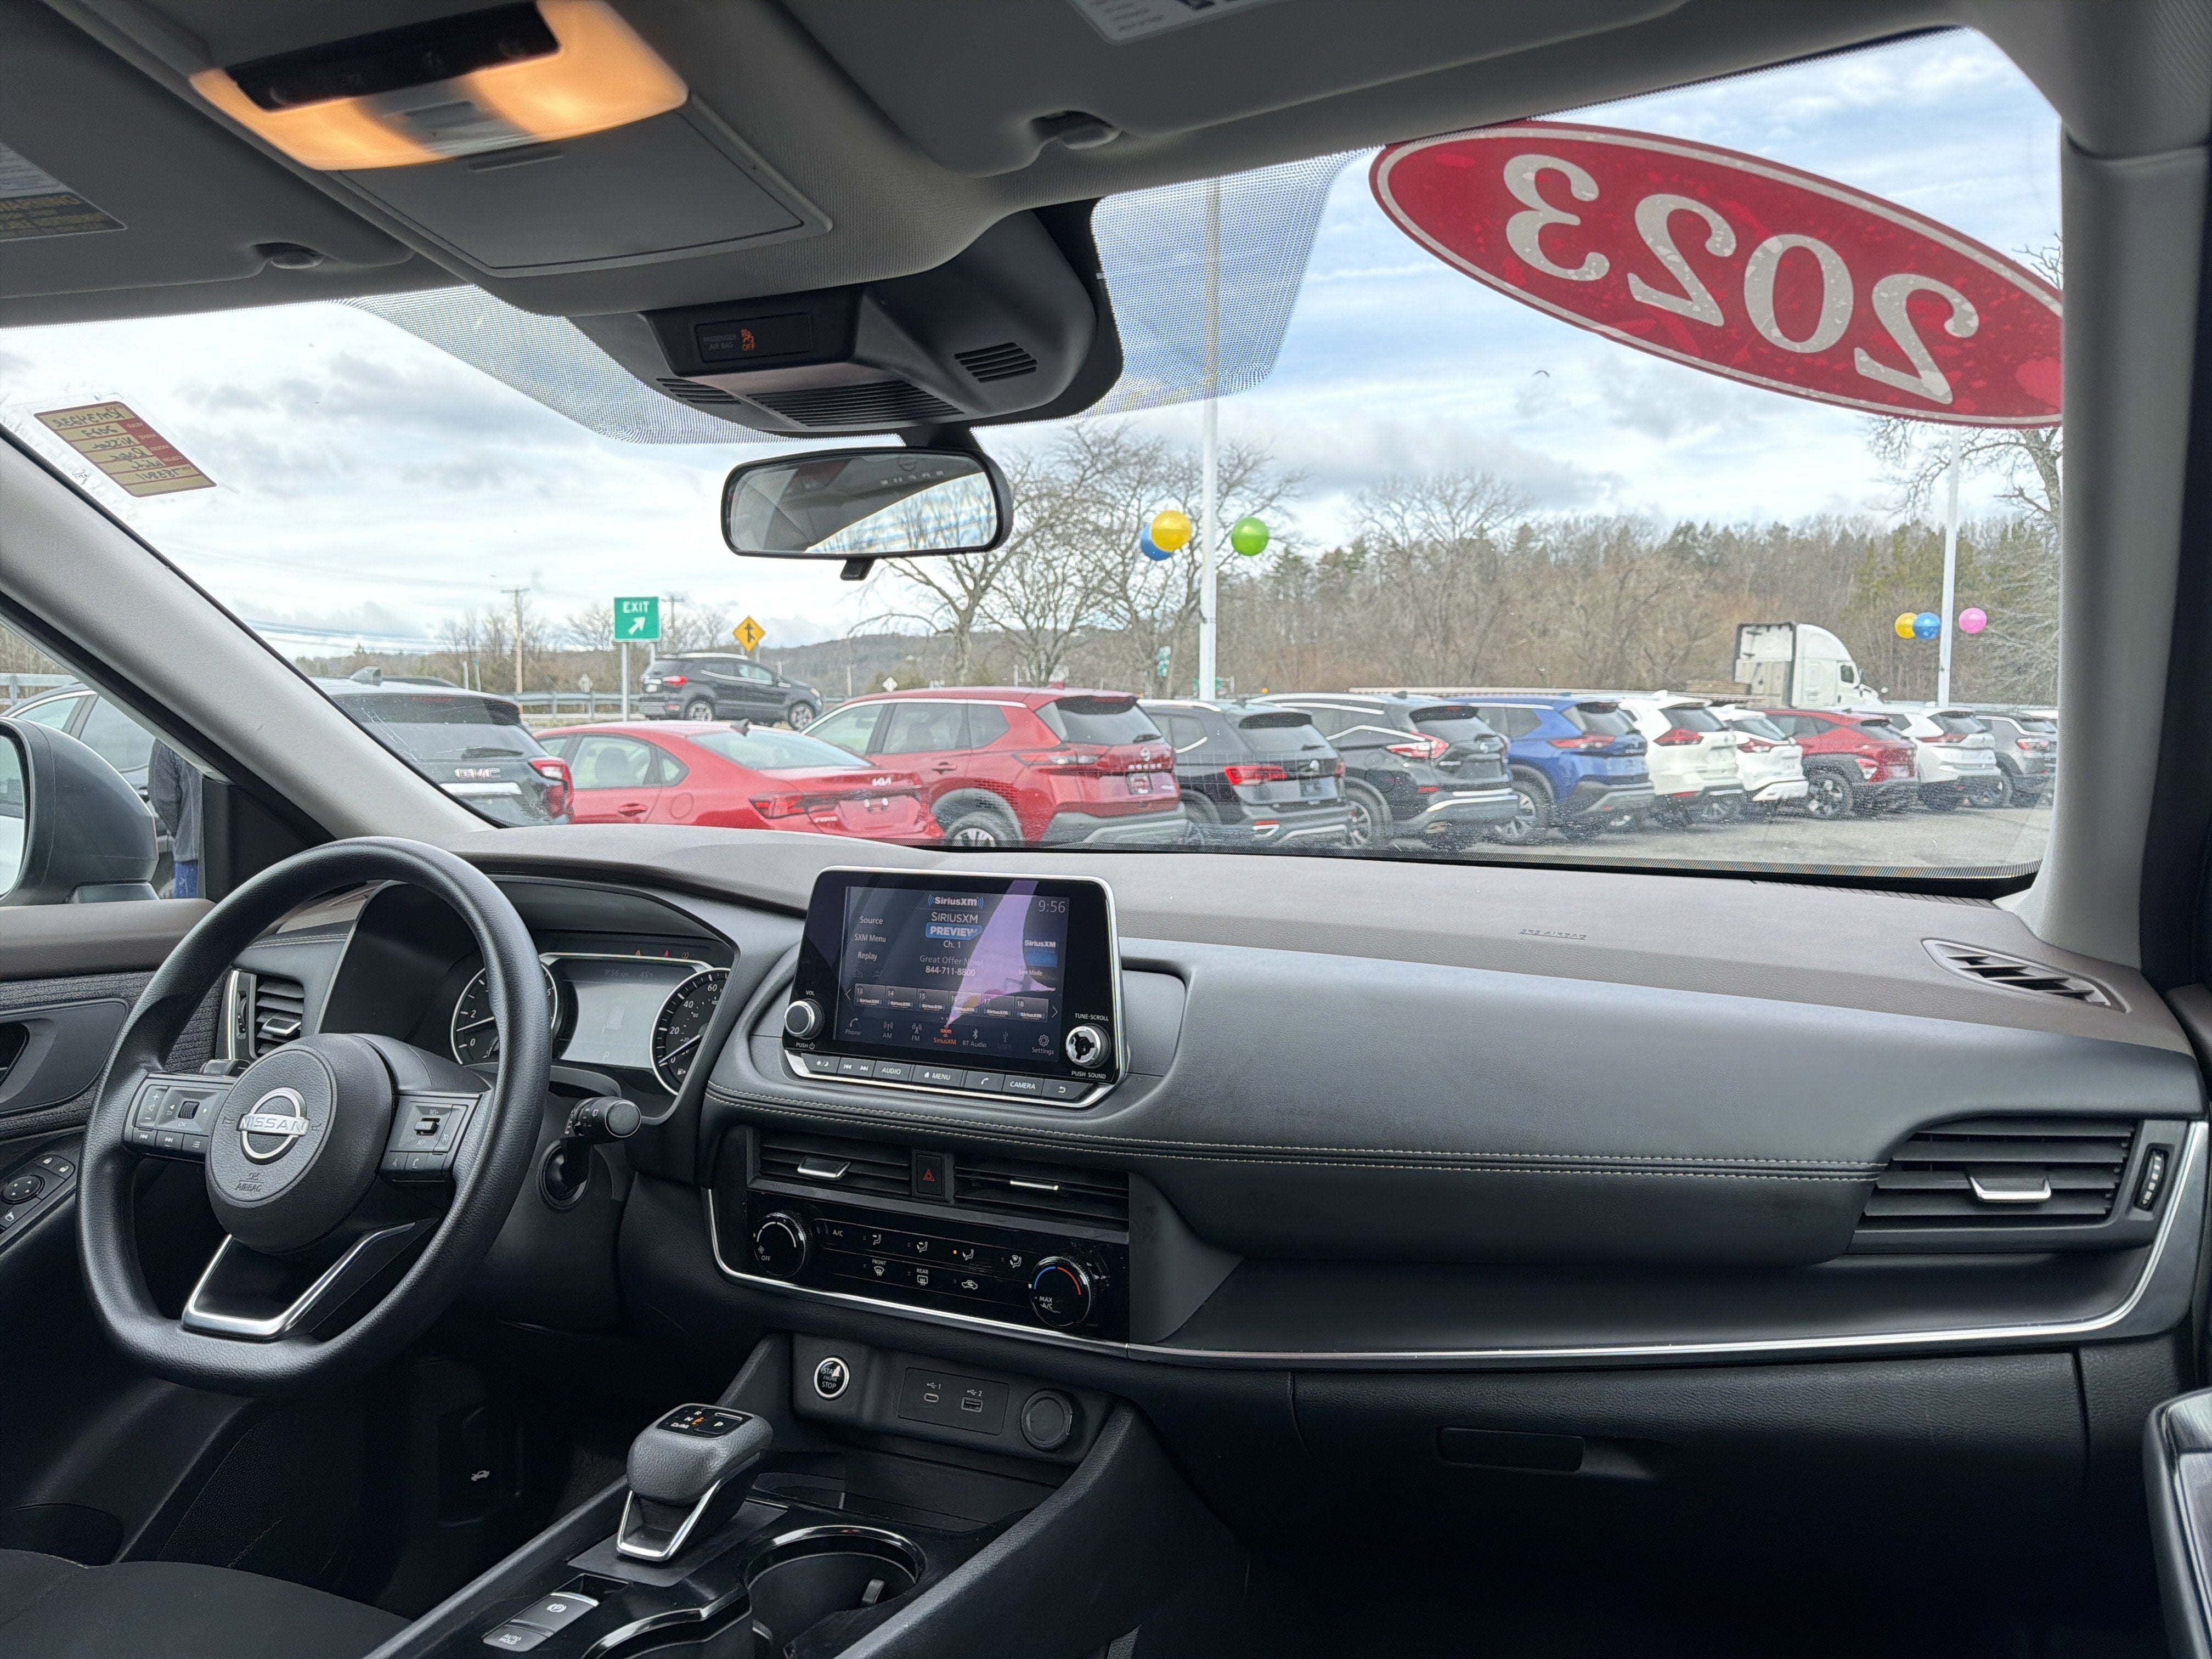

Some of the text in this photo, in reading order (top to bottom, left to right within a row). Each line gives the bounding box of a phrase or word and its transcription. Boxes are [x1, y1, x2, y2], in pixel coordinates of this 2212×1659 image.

[742, 343, 755, 351] OFF
[623, 601, 650, 613] EXIT
[454, 768, 501, 778] GMC
[1038, 900, 1066, 913] 9:56
[860, 916, 884, 925] Source
[931, 912, 978, 924] SIRIUSXM
[930, 926, 978, 937] PREVIEW
[854, 933, 886, 943] SXM Menu
[943, 940, 955, 948] Ch.
[857, 951, 878, 962] Replay
[919, 955, 940, 963] Great
[942, 956, 961, 965] Offer
[926, 966, 975, 977] 844-711-8800
[684, 1000, 693, 1008] 40
[470, 1009, 476, 1018] 2
[470, 1038, 476, 1046] 0
[1031, 1047, 1054, 1056] Settings
[1009, 1081, 1036, 1090] CAMERA
[240, 1117, 306, 1133] NISSAN
[823, 1367, 840, 1376] STA
